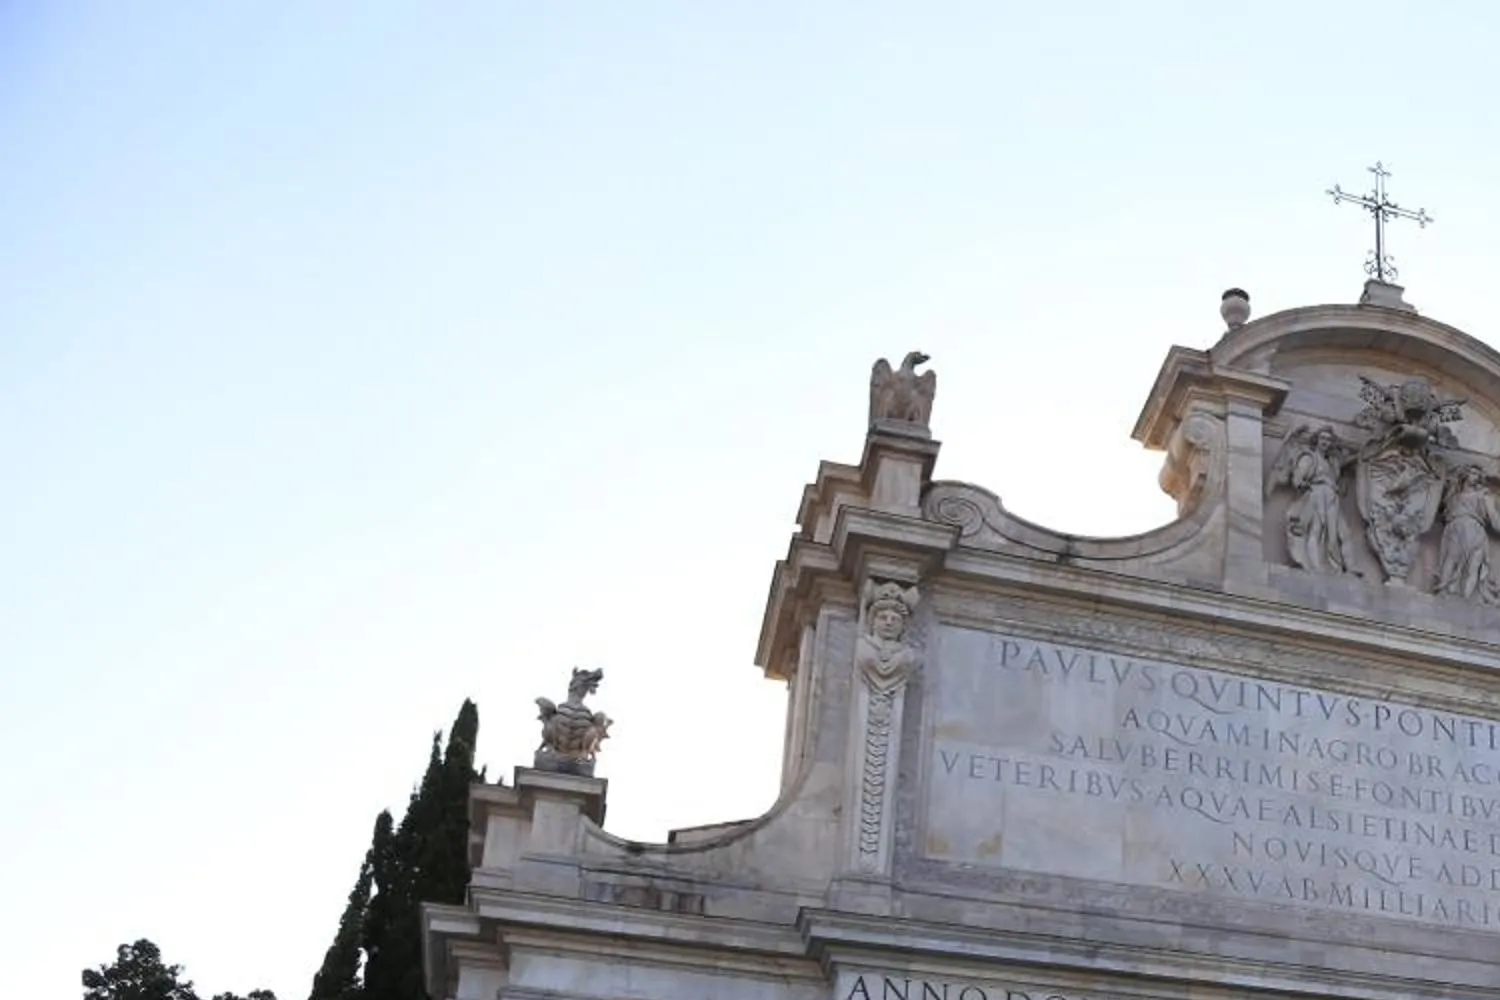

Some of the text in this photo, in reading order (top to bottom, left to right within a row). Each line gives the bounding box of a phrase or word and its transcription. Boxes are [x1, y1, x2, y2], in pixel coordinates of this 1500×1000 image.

[1001, 640, 1158, 691] PAVLVS
[1170, 671, 1361, 727] QVINTVS
[1050, 732, 1321, 792] SALVBERRIMIS
[1122, 708, 1251, 747] AQVAM
[1262, 729, 1300, 754] IN
[1307, 738, 1398, 770] AGRO
[940, 750, 1144, 801] VETERIBVS
[1154, 786, 1272, 824] AQVAE
[1283, 804, 1478, 851] ALSIETINAE
[1169, 858, 1267, 894] XXXV
[1280, 875, 1318, 901] AB
